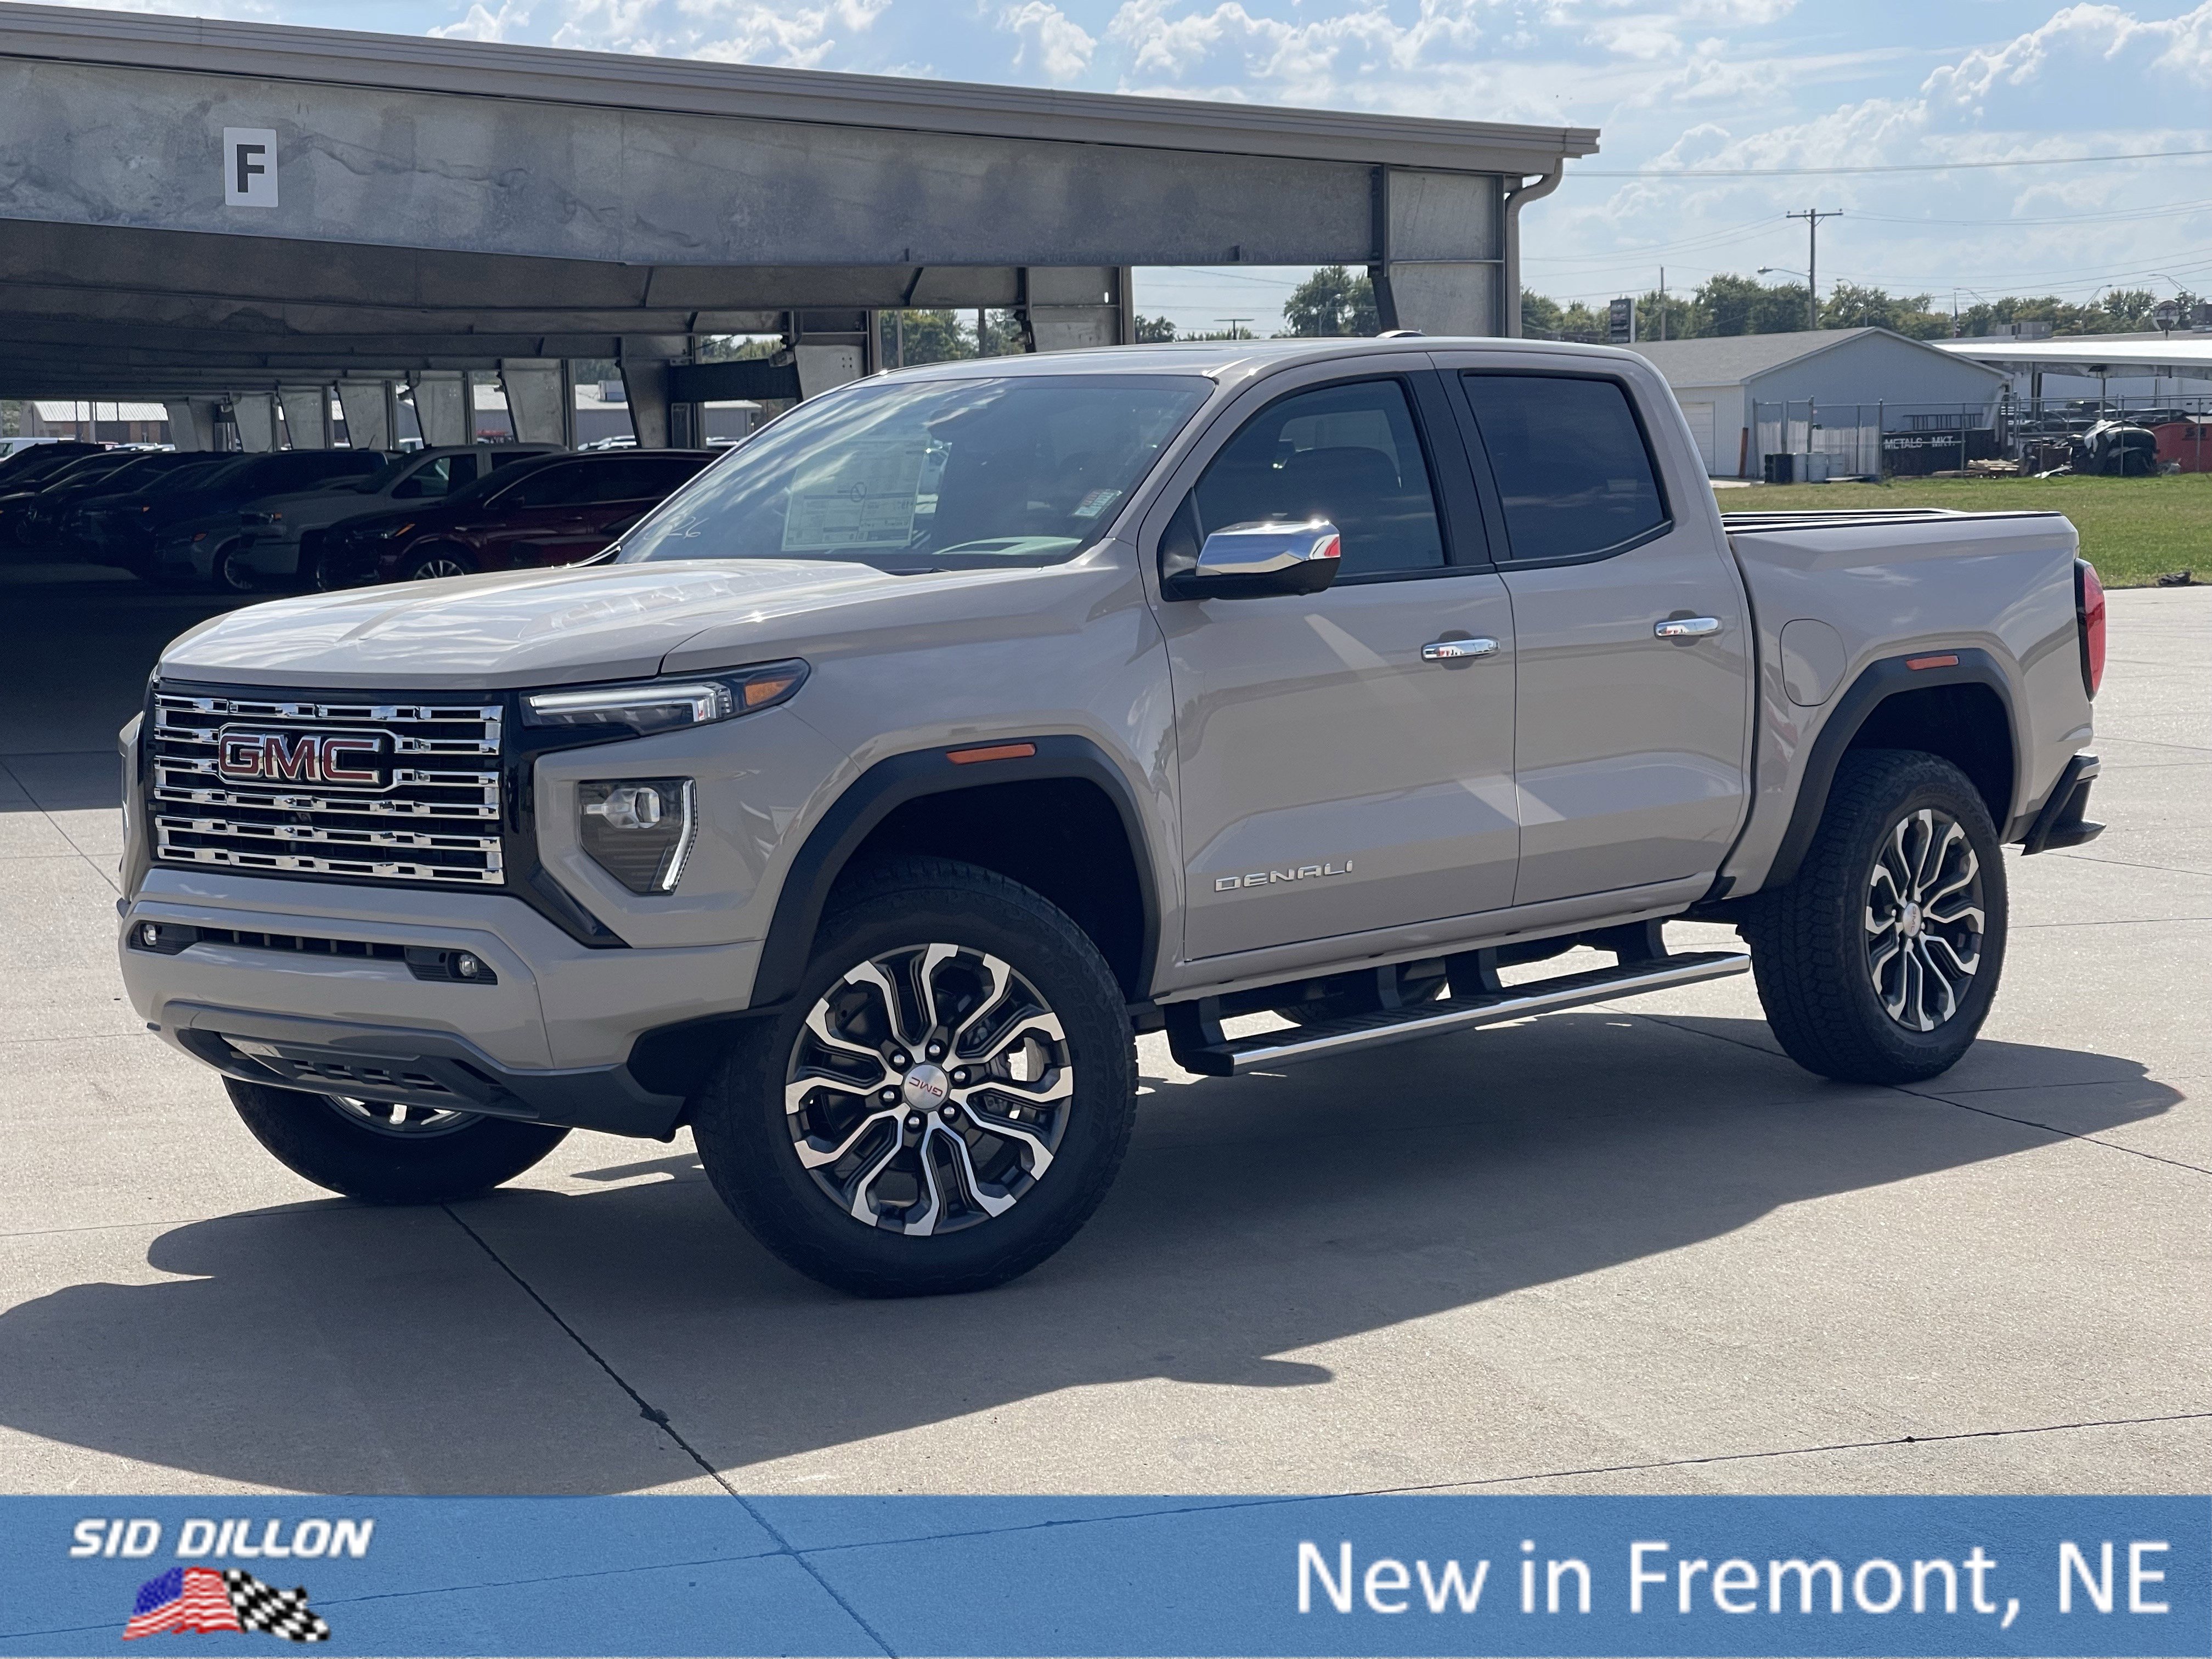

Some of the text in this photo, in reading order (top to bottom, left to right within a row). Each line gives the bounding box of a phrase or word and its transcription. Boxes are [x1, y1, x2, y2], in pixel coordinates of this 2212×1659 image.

[236, 144, 265, 193] F
[1884, 437, 1923, 450] METALS
[219, 732, 381, 784] GMC
[1215, 860, 1354, 891] DENALI
[909, 1076, 943, 1097] GMC
